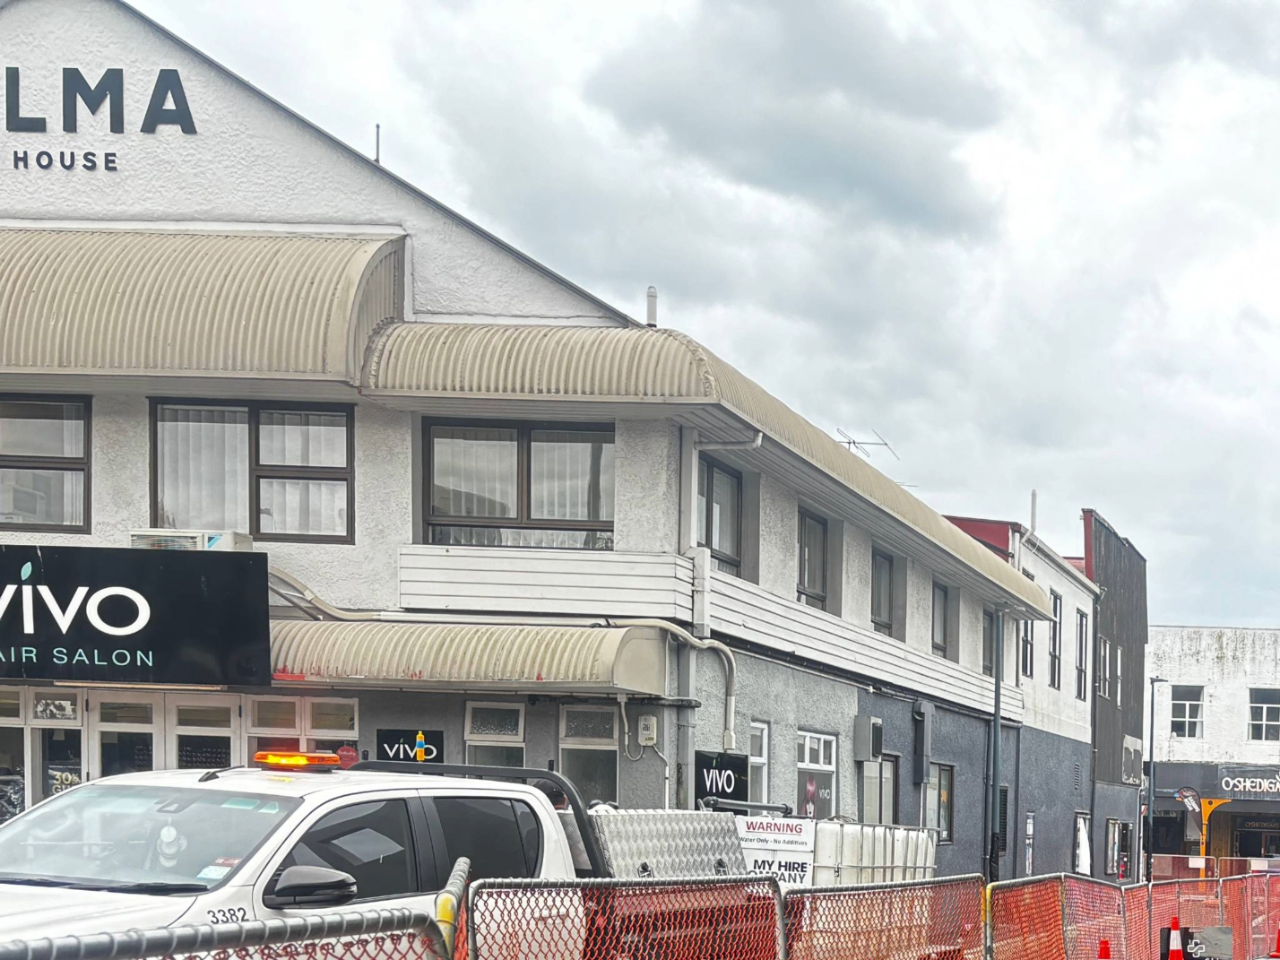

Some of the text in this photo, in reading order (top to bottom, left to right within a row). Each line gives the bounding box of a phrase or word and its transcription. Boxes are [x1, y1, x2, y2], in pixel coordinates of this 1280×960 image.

[13, 150, 118, 171] HOUSE
[0, 647, 153, 667] IR SALON
[383, 743, 438, 759] VIVO
[703, 768, 735, 793] VIVO
[746, 821, 802, 833] WARNING
[756, 837, 770, 845] Only
[753, 859, 808, 873] MY HIRE
[206, 907, 250, 925] 3382
